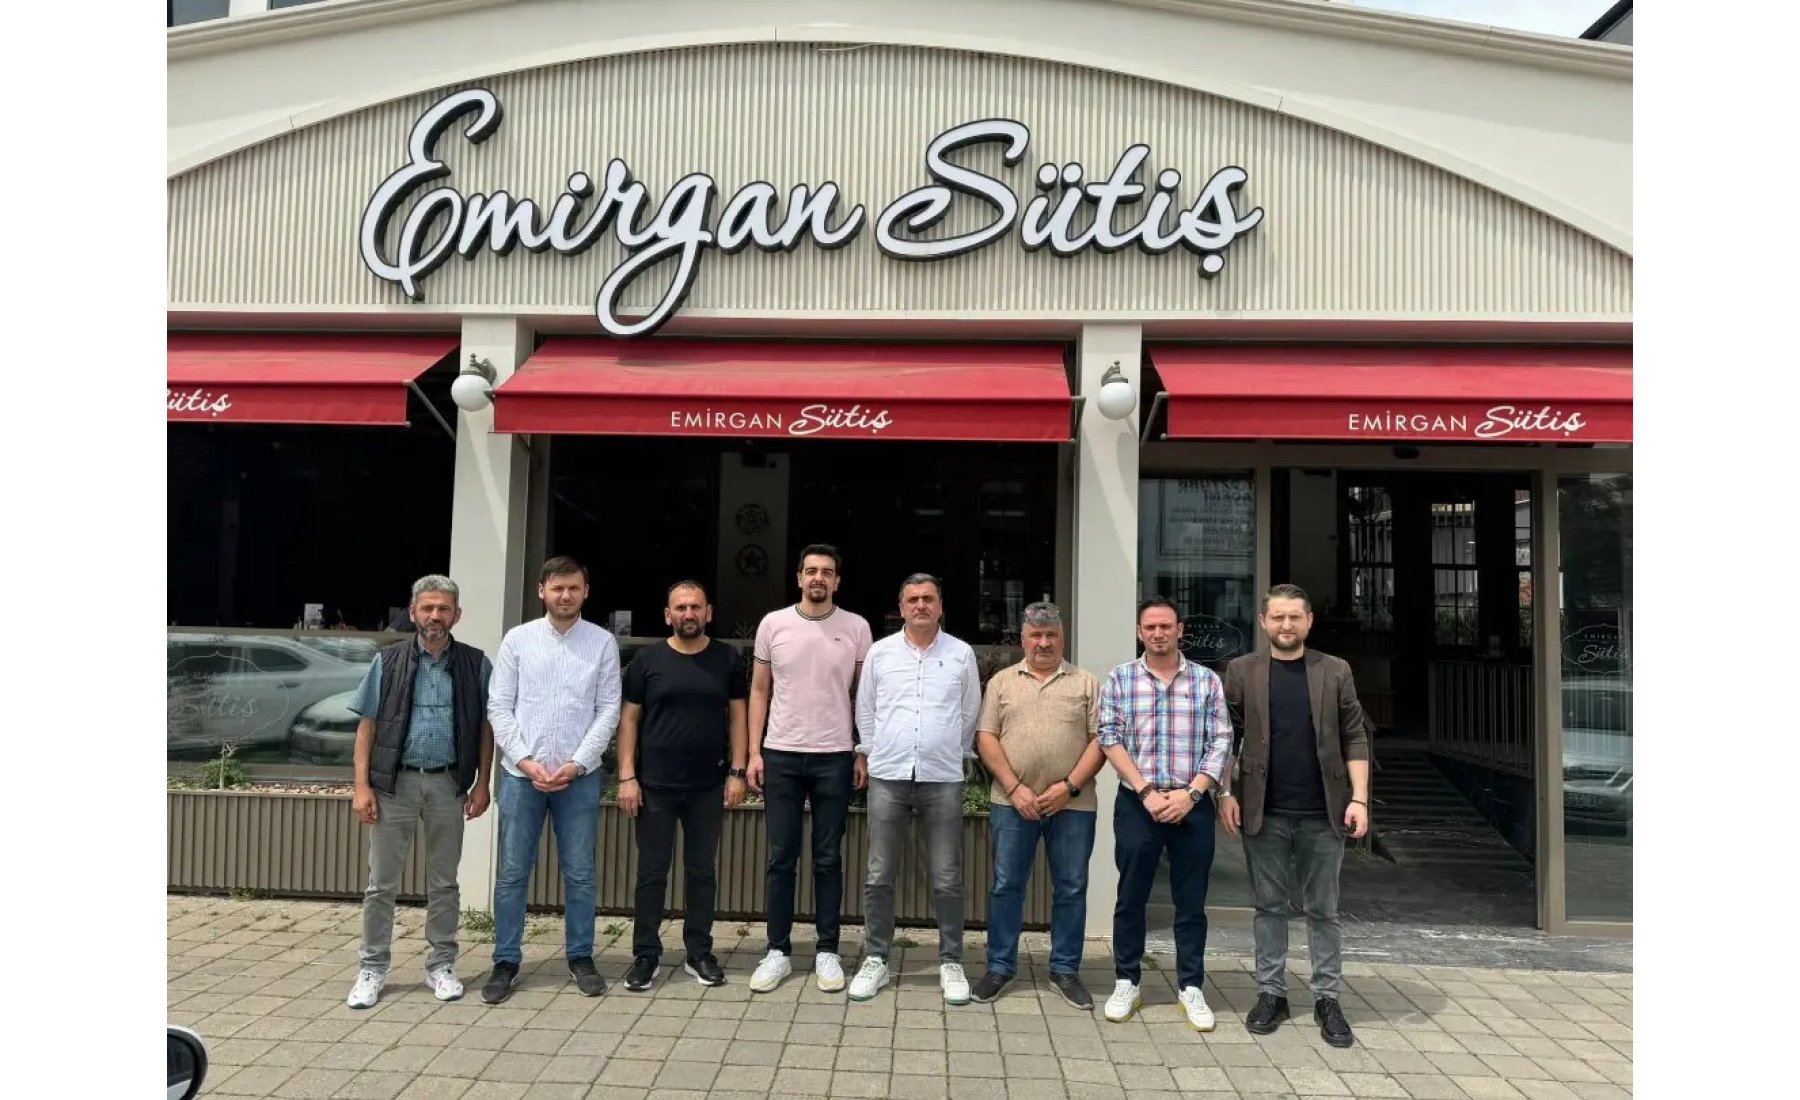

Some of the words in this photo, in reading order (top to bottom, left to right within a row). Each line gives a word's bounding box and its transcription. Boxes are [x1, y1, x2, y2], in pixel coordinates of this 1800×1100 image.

[360, 87, 866, 337] Emirgan
[876, 117, 1264, 279] Sütiş
[670, 408, 782, 430] EMİRGAN
[788, 404, 893, 436] Sütiş
[1348, 410, 1468, 432] EMİRGAN
[1474, 405, 1586, 438] Sütiş
